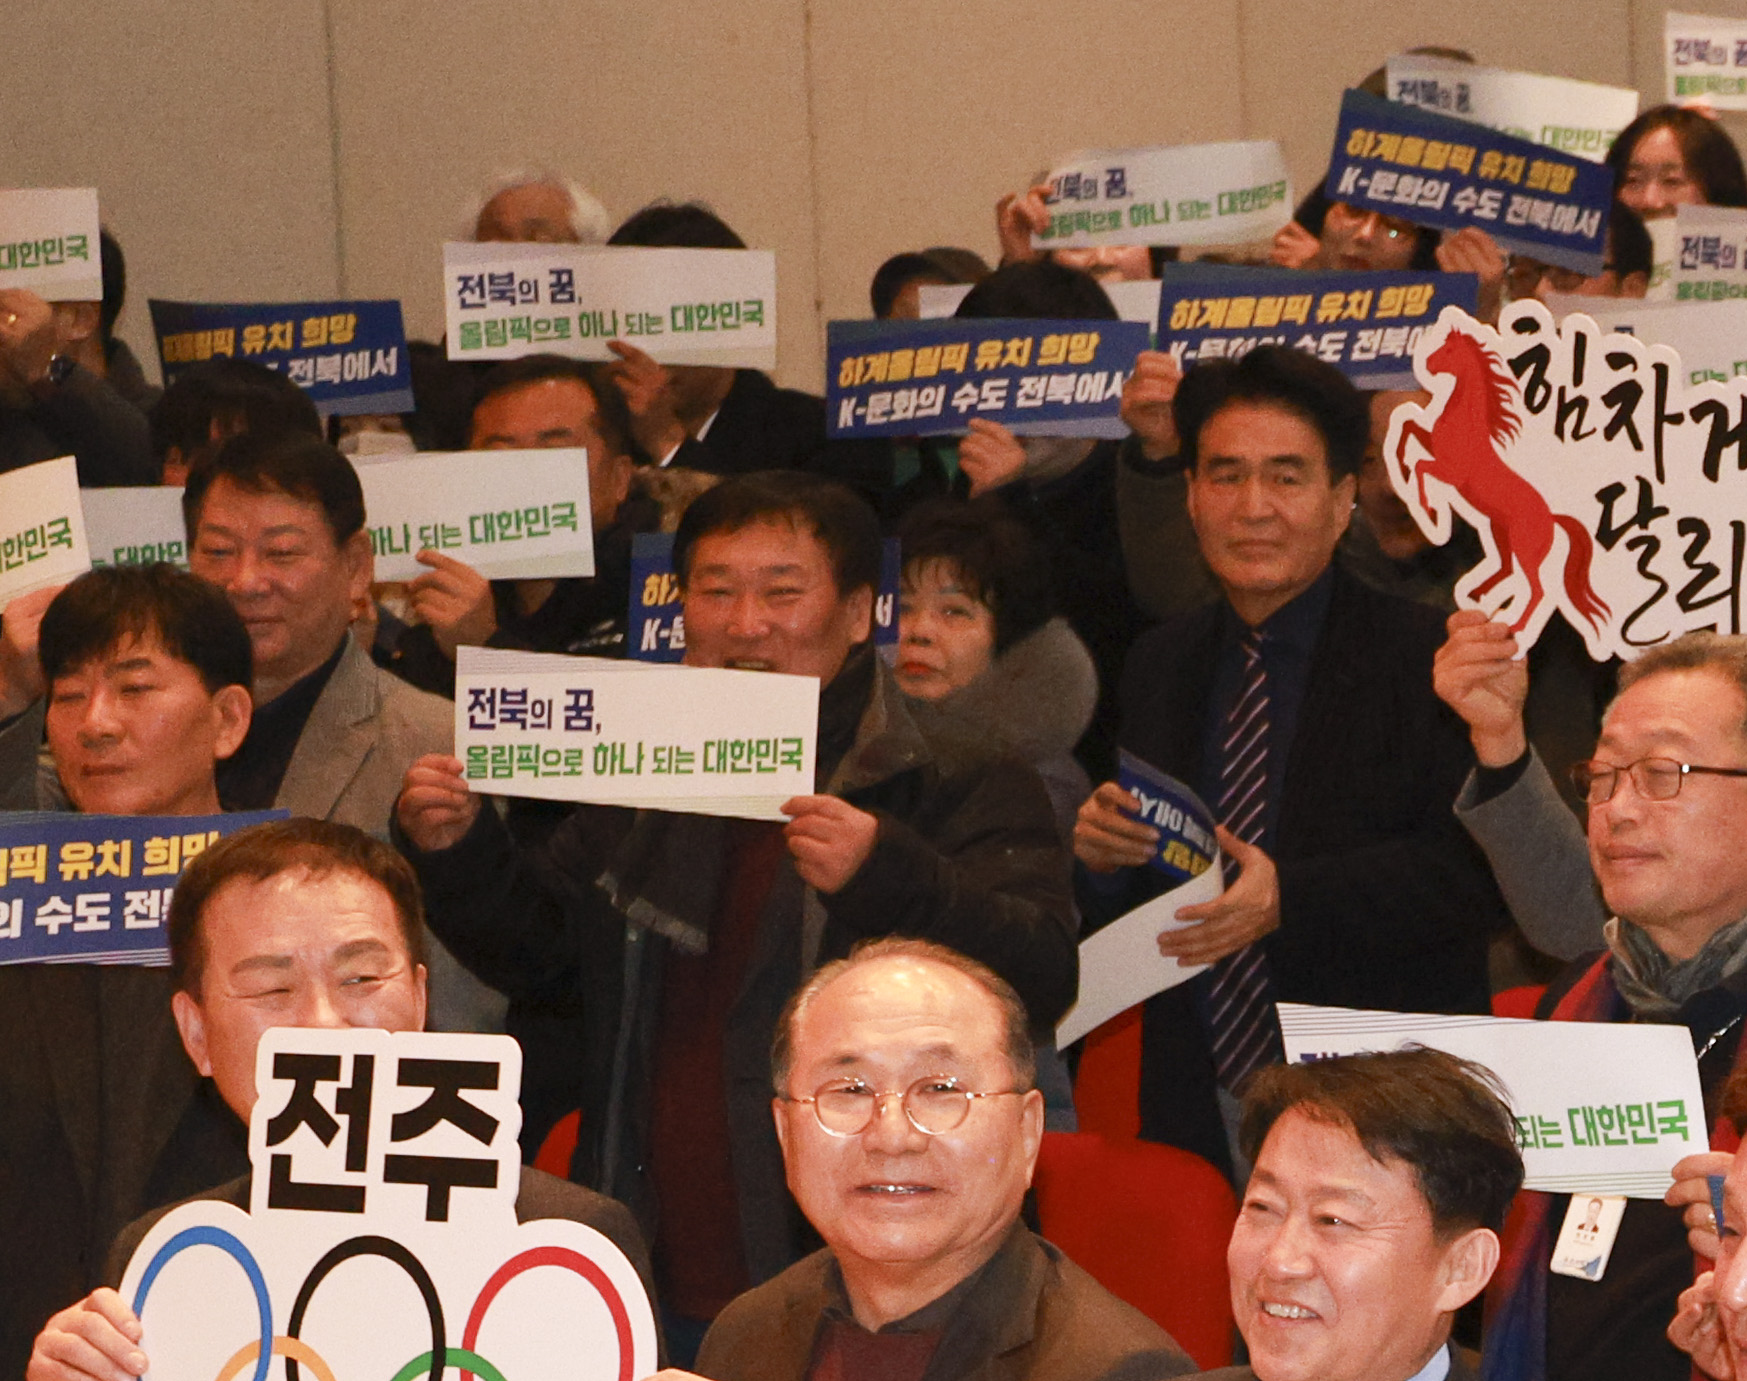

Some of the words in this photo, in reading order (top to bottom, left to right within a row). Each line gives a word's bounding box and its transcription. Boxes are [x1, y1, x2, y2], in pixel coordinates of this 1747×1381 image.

[1451, 184, 1506, 221] 수도
[1679, 234, 1739, 271] 전북의
[457, 270, 540, 310] 전북의
[1168, 294, 1313, 332] 하계올림픽
[1314, 288, 1373, 325] 유치
[1374, 282, 1435, 320] 희망
[241, 320, 294, 355] 유치
[301, 312, 357, 348] 희망
[459, 314, 571, 351] 올림픽으로
[578, 309, 618, 339] 하나
[625, 310, 664, 336] 되는
[670, 298, 765, 335] 대한민국
[837, 341, 970, 388] 하계올림픽
[974, 336, 1034, 372] 유치
[1036, 330, 1101, 367] 희망
[837, 384, 947, 430] K-문화의
[951, 377, 1010, 414] 수도
[0, 516, 74, 572] 한민국
[418, 523, 462, 549] 되는
[469, 501, 579, 546] 대한민국
[466, 686, 553, 732] 전북의
[563, 685, 602, 735] 꿈,
[465, 742, 584, 780] 올림픽으로
[593, 740, 645, 777] 하나
[652, 746, 696, 775] 되는
[702, 736, 804, 774] 대한민국
[58, 838, 132, 882] 유치
[34, 892, 111, 935] 수도
[265, 1051, 502, 1223] 전주
[1566, 1099, 1691, 1149] 대한민국
